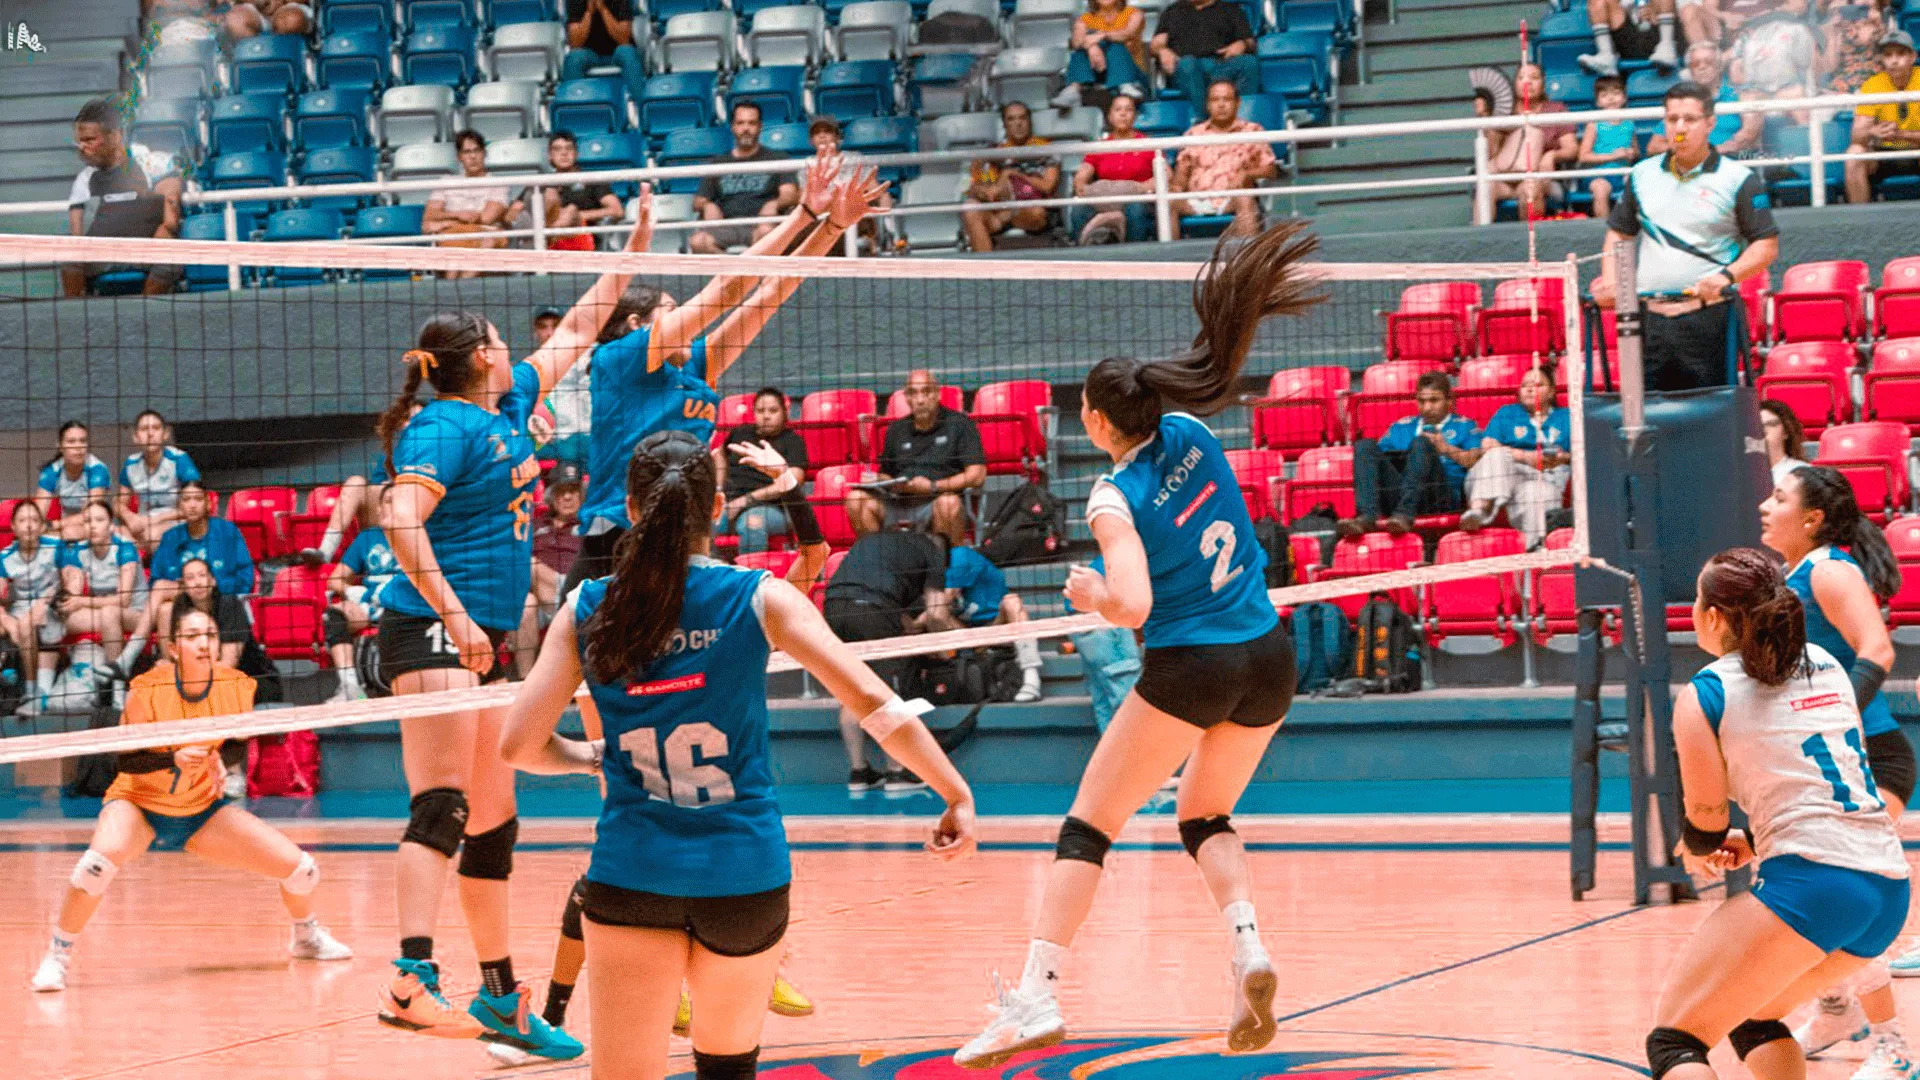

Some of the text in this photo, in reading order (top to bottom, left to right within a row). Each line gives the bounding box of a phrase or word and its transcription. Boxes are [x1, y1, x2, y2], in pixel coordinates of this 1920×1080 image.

[1183, 445, 1204, 470] CHI
[1200, 520, 1244, 593] 2
[689, 628, 722, 651] CH
[619, 722, 736, 809] 16
[1801, 727, 1886, 812] 11
